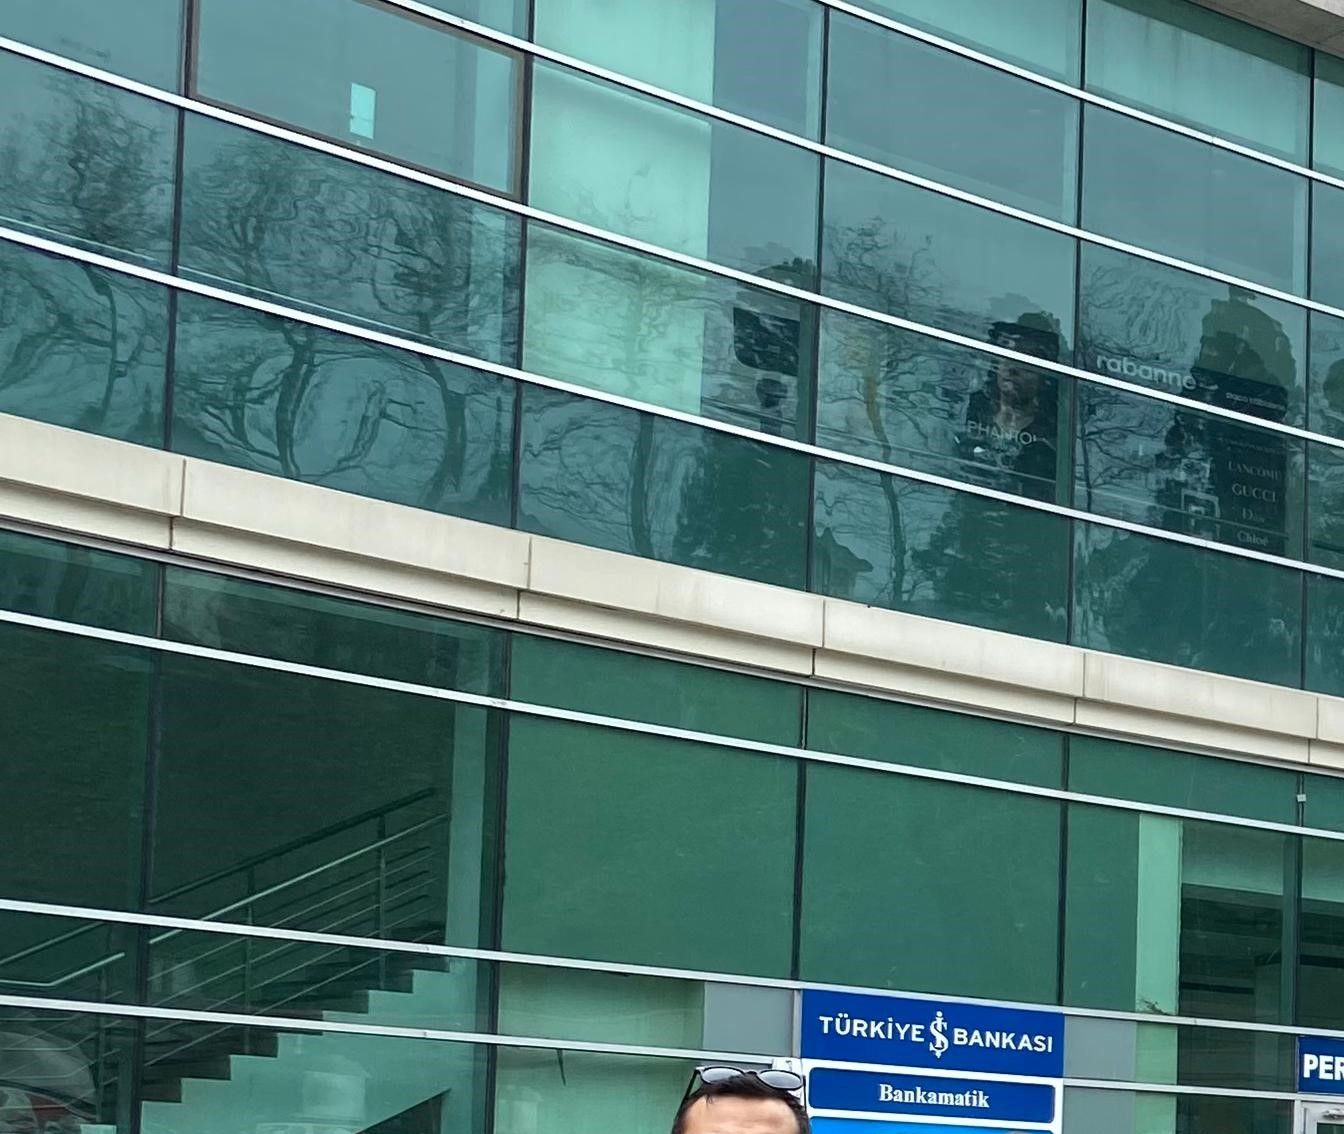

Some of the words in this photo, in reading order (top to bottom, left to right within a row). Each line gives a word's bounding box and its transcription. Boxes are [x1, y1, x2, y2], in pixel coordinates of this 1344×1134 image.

[1096, 354, 1197, 391] rabanne
[967, 419, 1037, 445] PHANTO
[1231, 482, 1276, 503] GUCCI
[818, 1013, 925, 1043] TÜRKİYE
[953, 1028, 1054, 1054] BANKASI
[879, 1083, 991, 1109] Bankamatik
